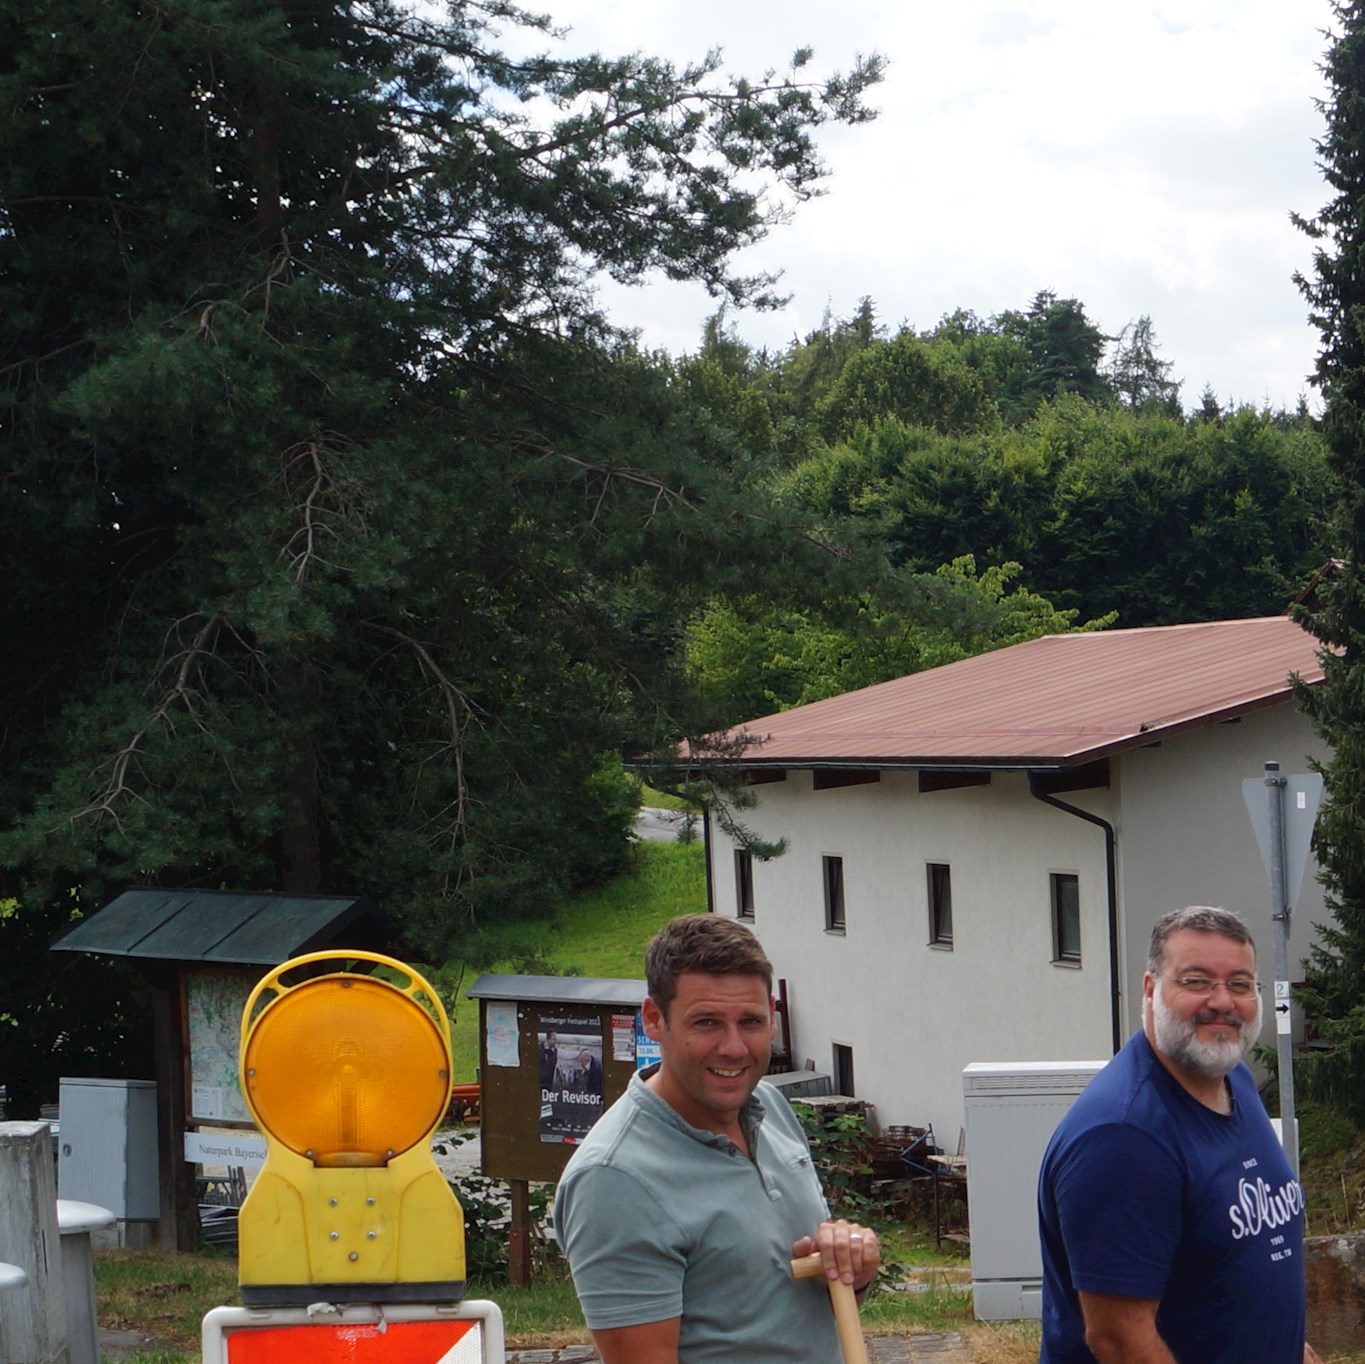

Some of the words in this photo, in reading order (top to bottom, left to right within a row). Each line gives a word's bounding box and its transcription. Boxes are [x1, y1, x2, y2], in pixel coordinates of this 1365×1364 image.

[541, 1089, 559, 1102] Der
[562, 1089, 601, 1105] Revisor
[199, 1144, 233, 1157] Naturpark
